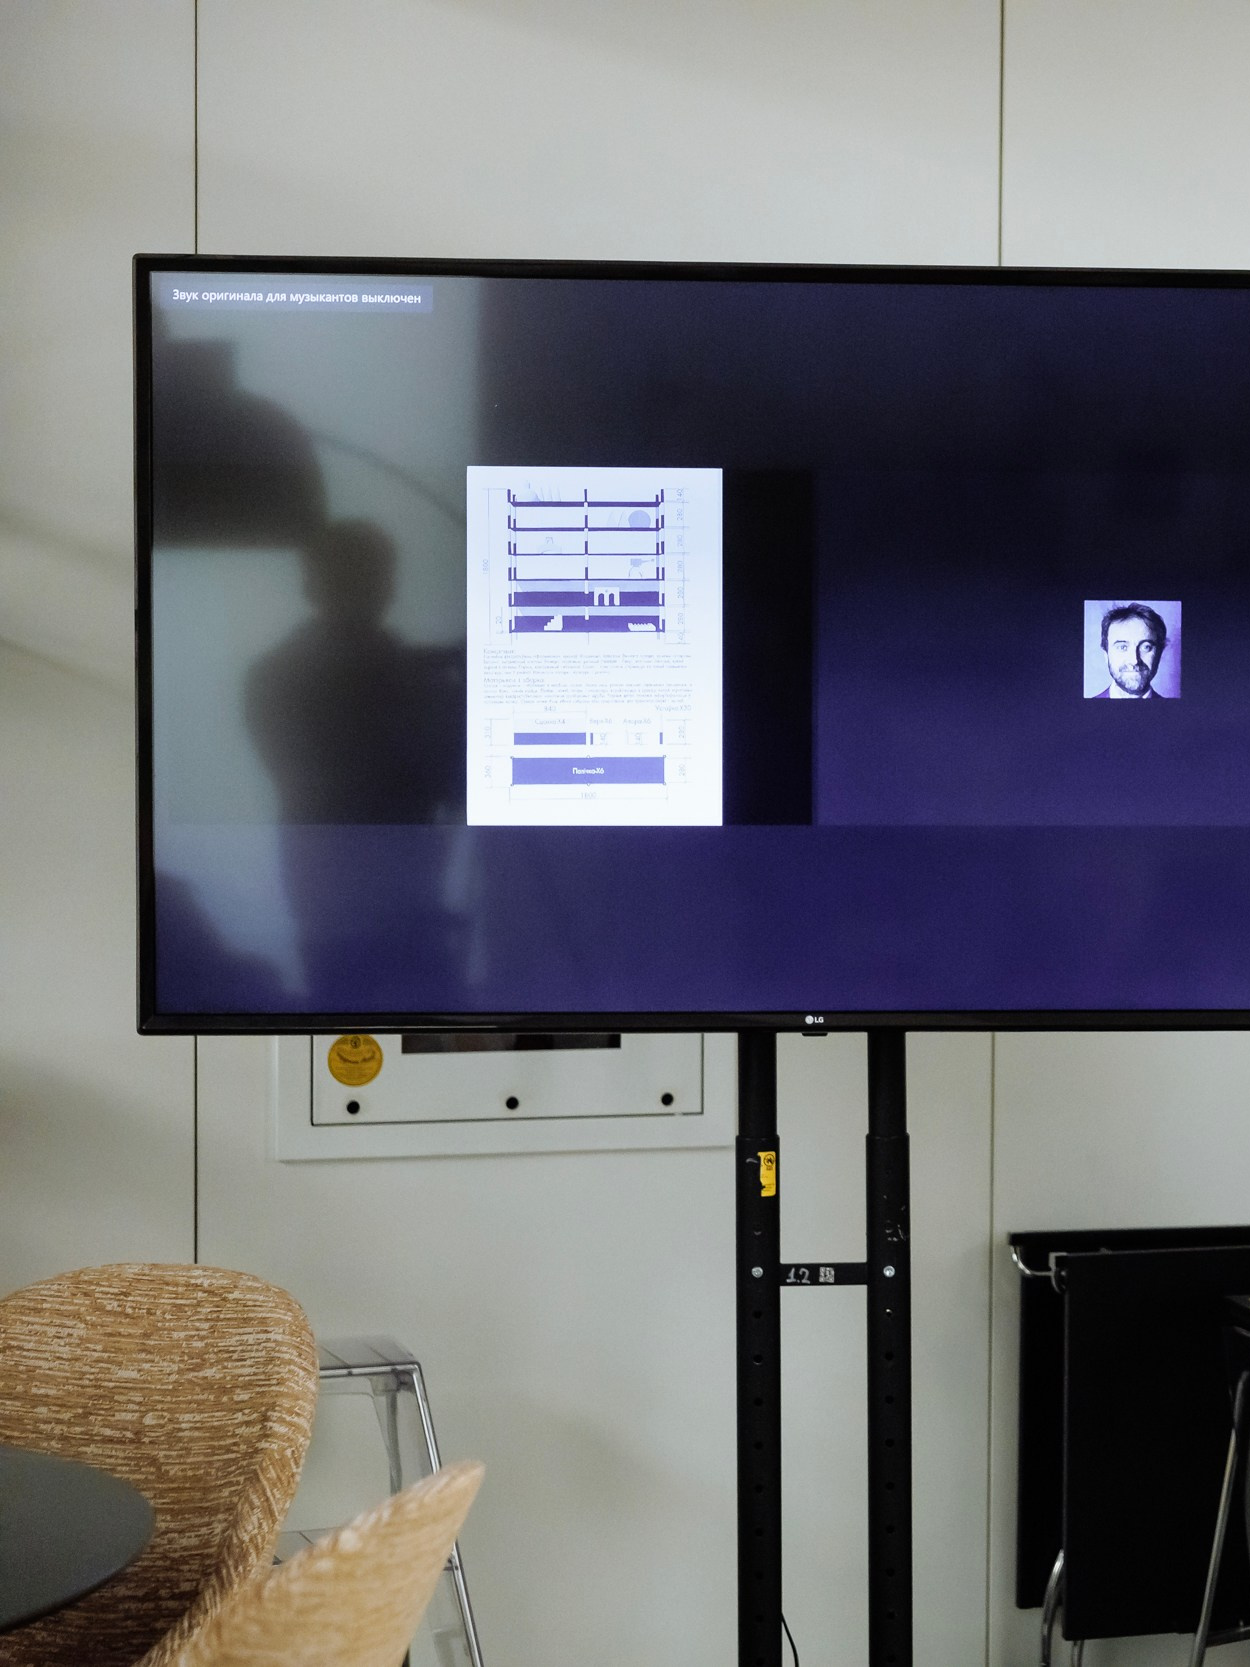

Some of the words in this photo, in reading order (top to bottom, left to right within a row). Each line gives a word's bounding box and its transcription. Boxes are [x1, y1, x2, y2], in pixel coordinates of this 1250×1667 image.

[172, 289, 199, 303] Звук
[202, 291, 263, 303] оригинала
[266, 292, 287, 303] для
[289, 293, 358, 304] музыкантов
[361, 294, 421, 304] выключен
[786, 1267, 811, 1284] 1.2
